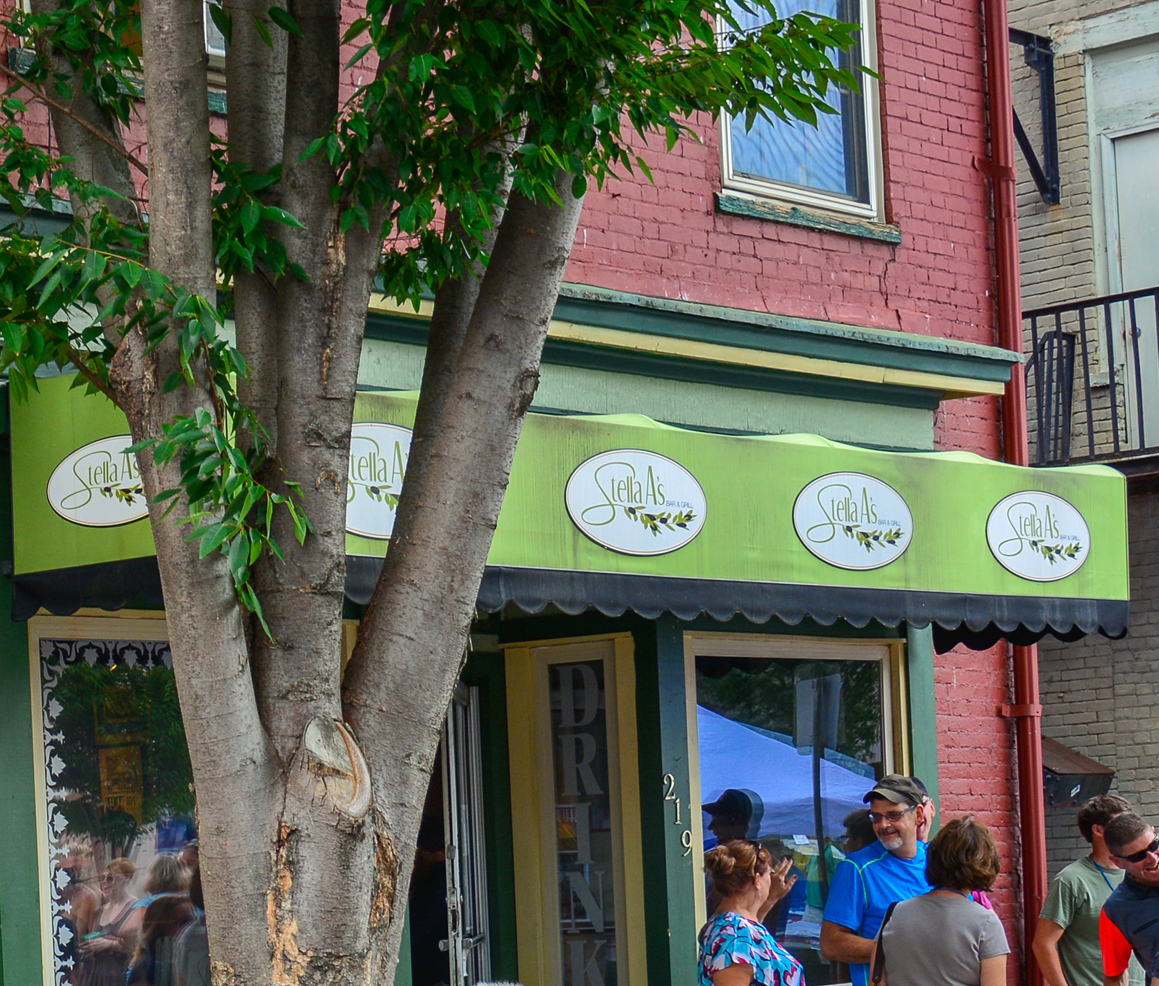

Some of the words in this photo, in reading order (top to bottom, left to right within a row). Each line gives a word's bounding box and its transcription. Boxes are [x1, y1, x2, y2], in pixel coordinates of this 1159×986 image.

[60, 450, 118, 510] Stella
[581, 461, 643, 526] Stella
[645, 465, 666, 506] A's
[806, 483, 858, 543] Stella
[860, 487, 878, 525] A's
[998, 501, 1042, 557] Stella
[1044, 504, 1059, 539] A's
[663, 773, 693, 857] 219
